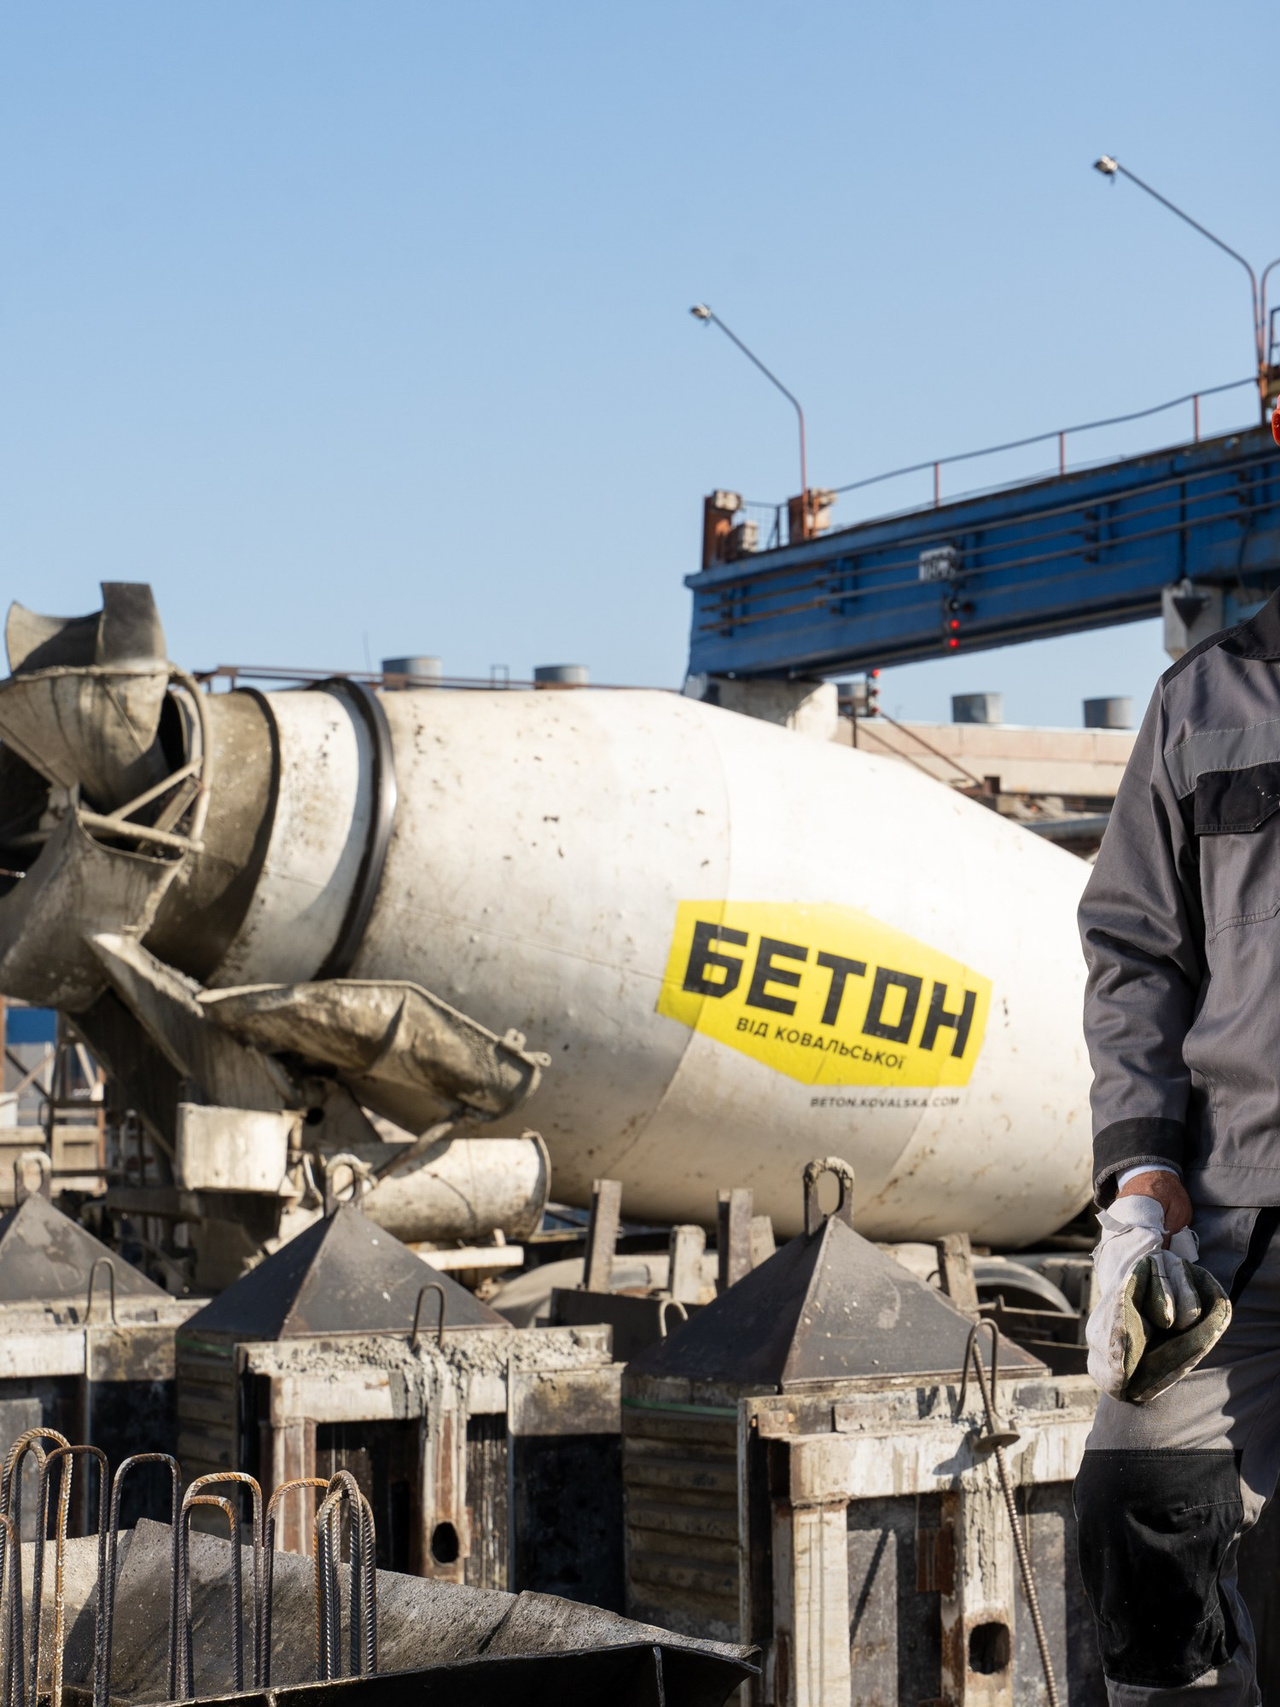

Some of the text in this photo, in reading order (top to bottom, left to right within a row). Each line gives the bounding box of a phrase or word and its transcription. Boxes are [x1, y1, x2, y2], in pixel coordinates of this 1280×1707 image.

[682, 920, 978, 1059] БЕТОН
[736, 1017, 905, 1071] ВІД КОВАЛЬСЬКОЇ
[810, 1095, 961, 1109] BETON.KOVALSKA.COM
